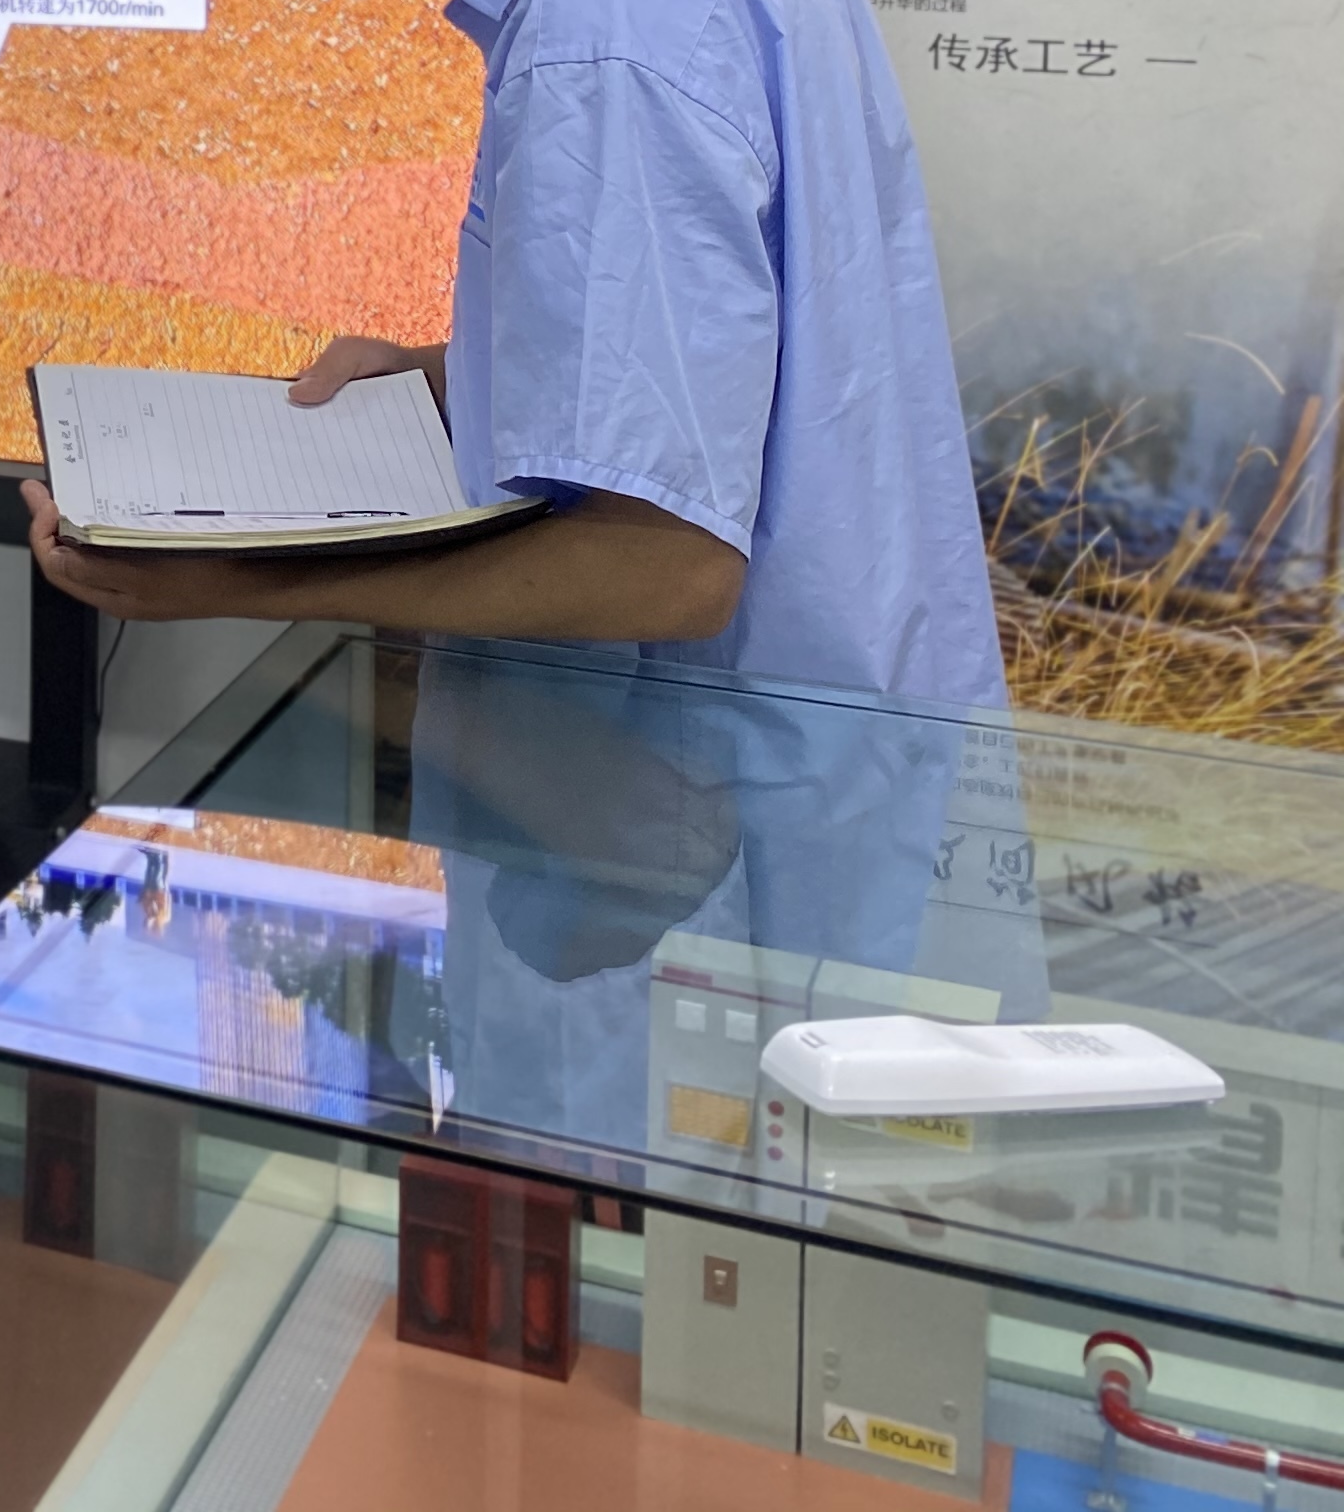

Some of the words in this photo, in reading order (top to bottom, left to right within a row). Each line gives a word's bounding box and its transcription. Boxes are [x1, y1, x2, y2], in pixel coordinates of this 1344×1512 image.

[928, 34, 1119, 78] 传承工艺
[872, 1426, 950, 1458] ISOLATE
